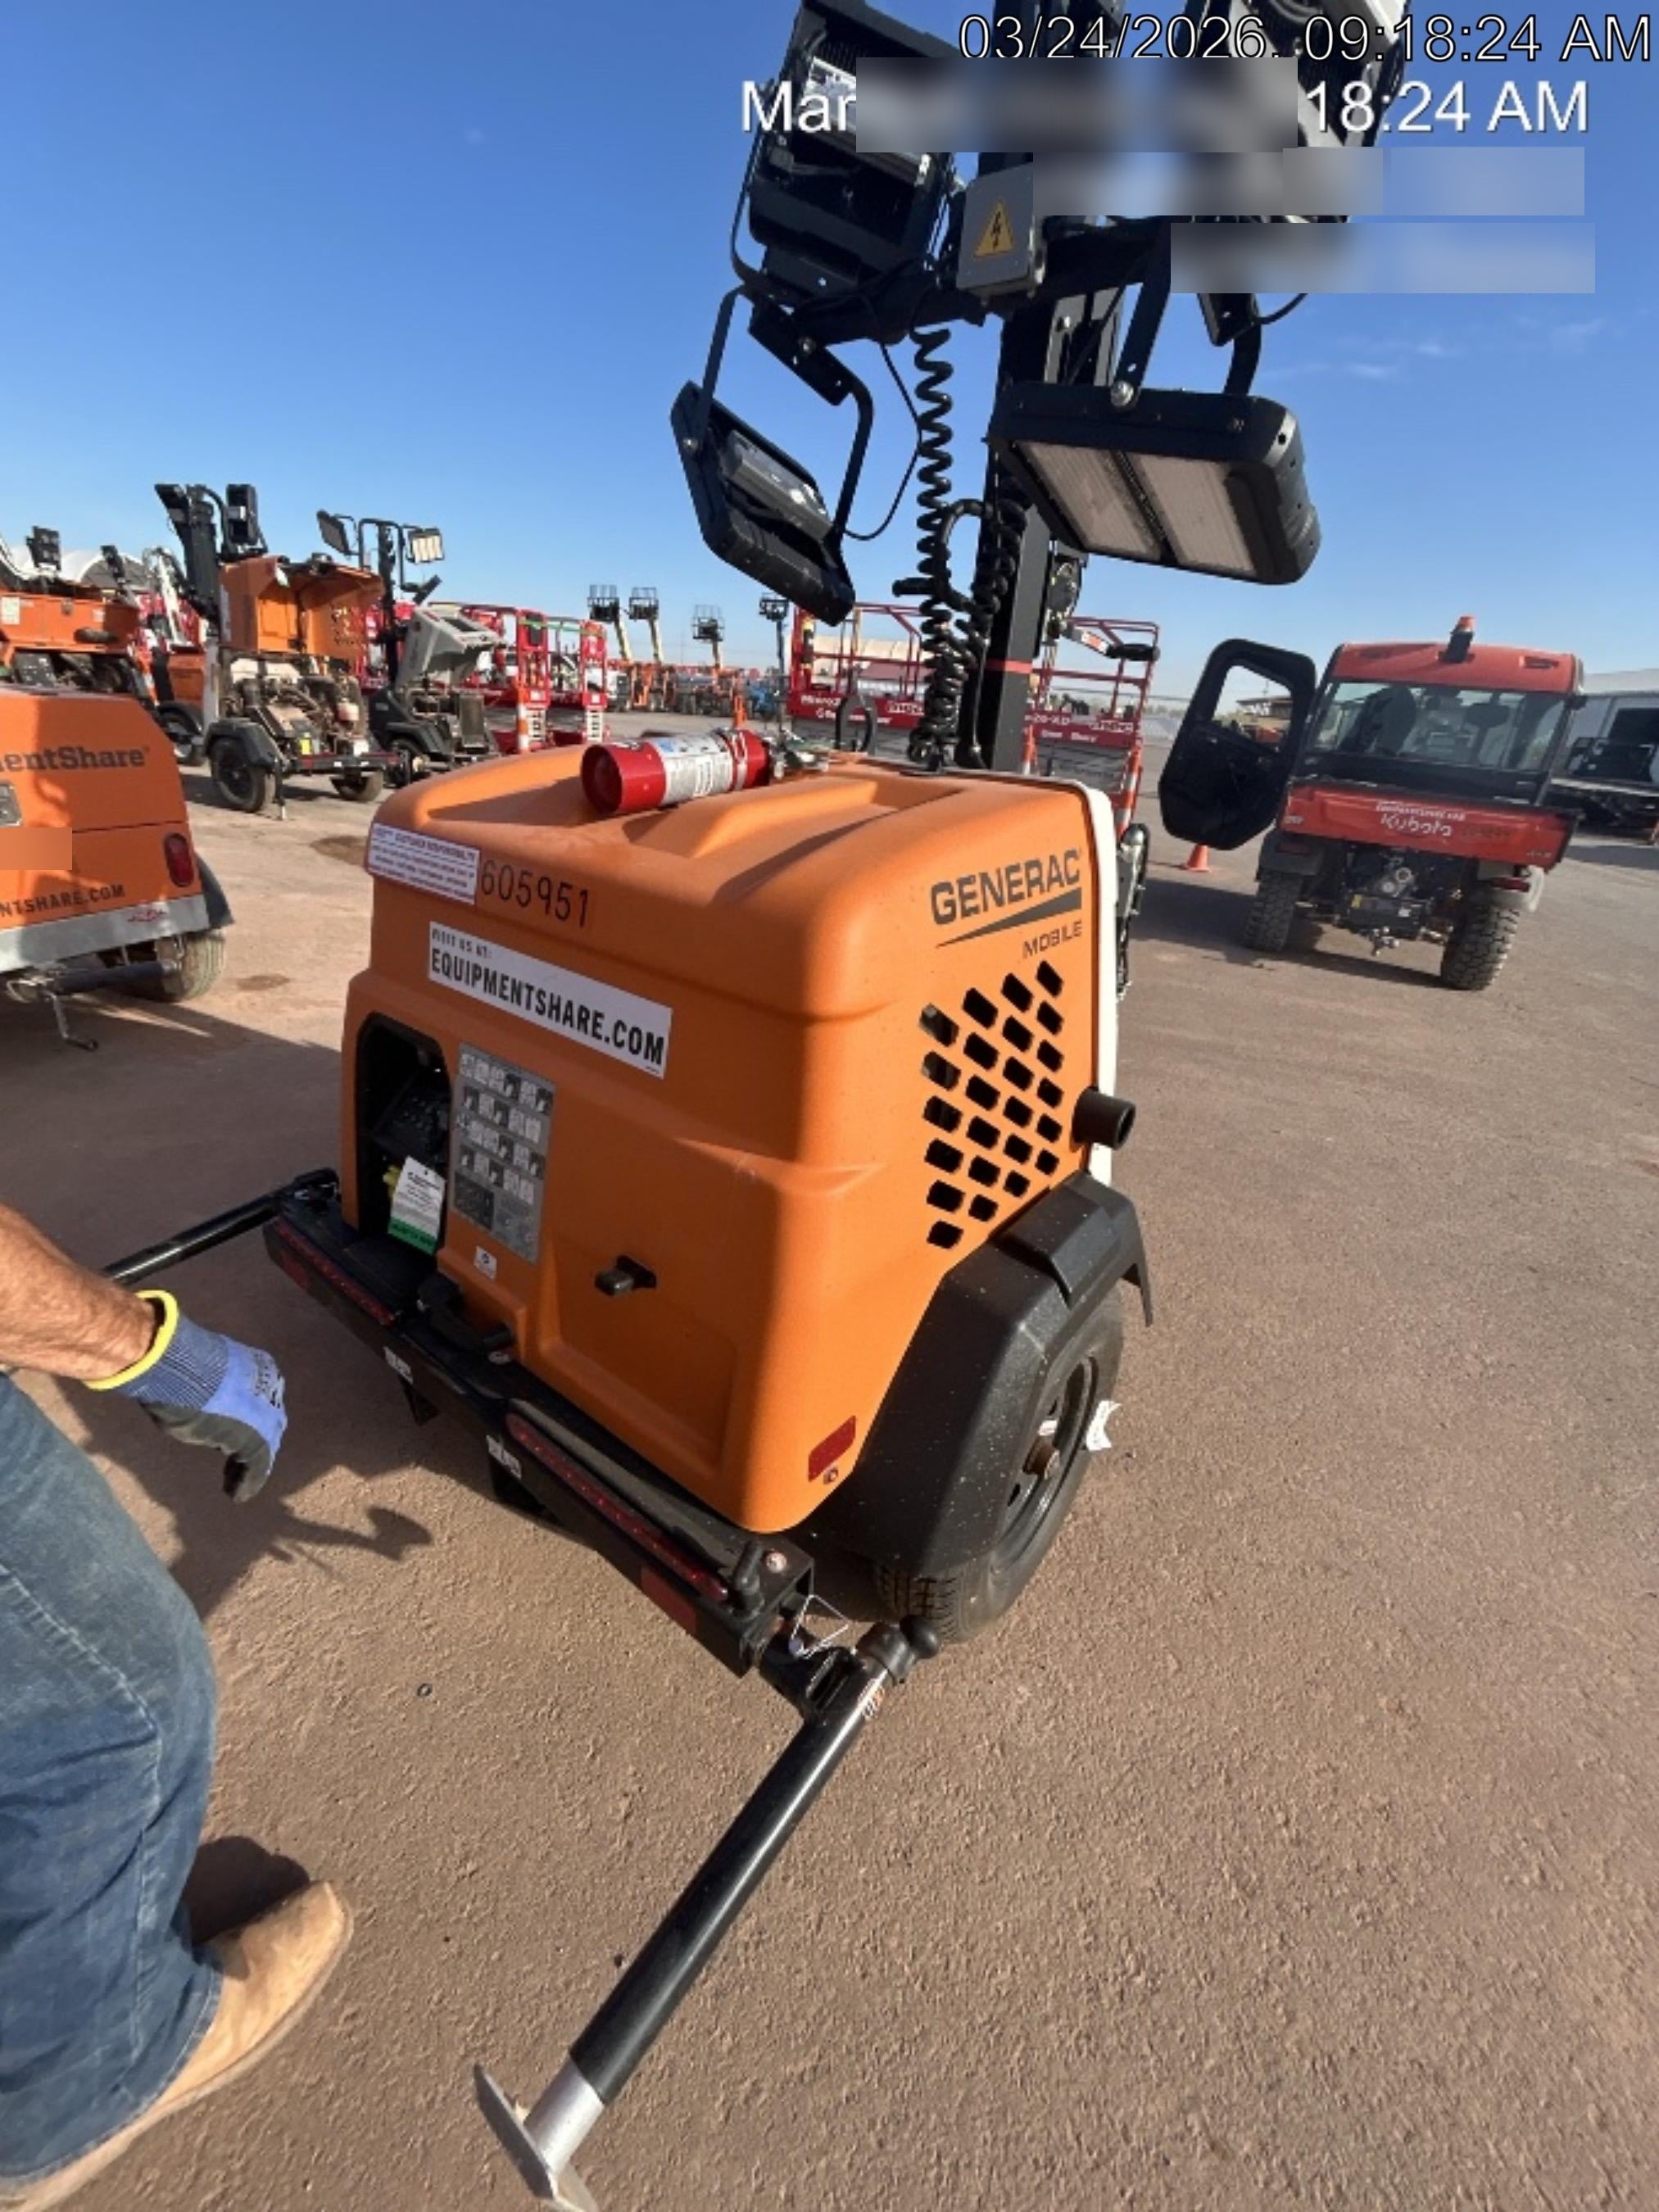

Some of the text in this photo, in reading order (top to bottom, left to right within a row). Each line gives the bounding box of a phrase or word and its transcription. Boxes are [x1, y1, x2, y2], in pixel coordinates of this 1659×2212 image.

[481, 859, 588, 927] 605951
[931, 849, 1080, 925] GENERAC
[1023, 920, 1082, 958] MOBILE
[432, 948, 664, 1065] EQUIPMENTSHARE.COM
